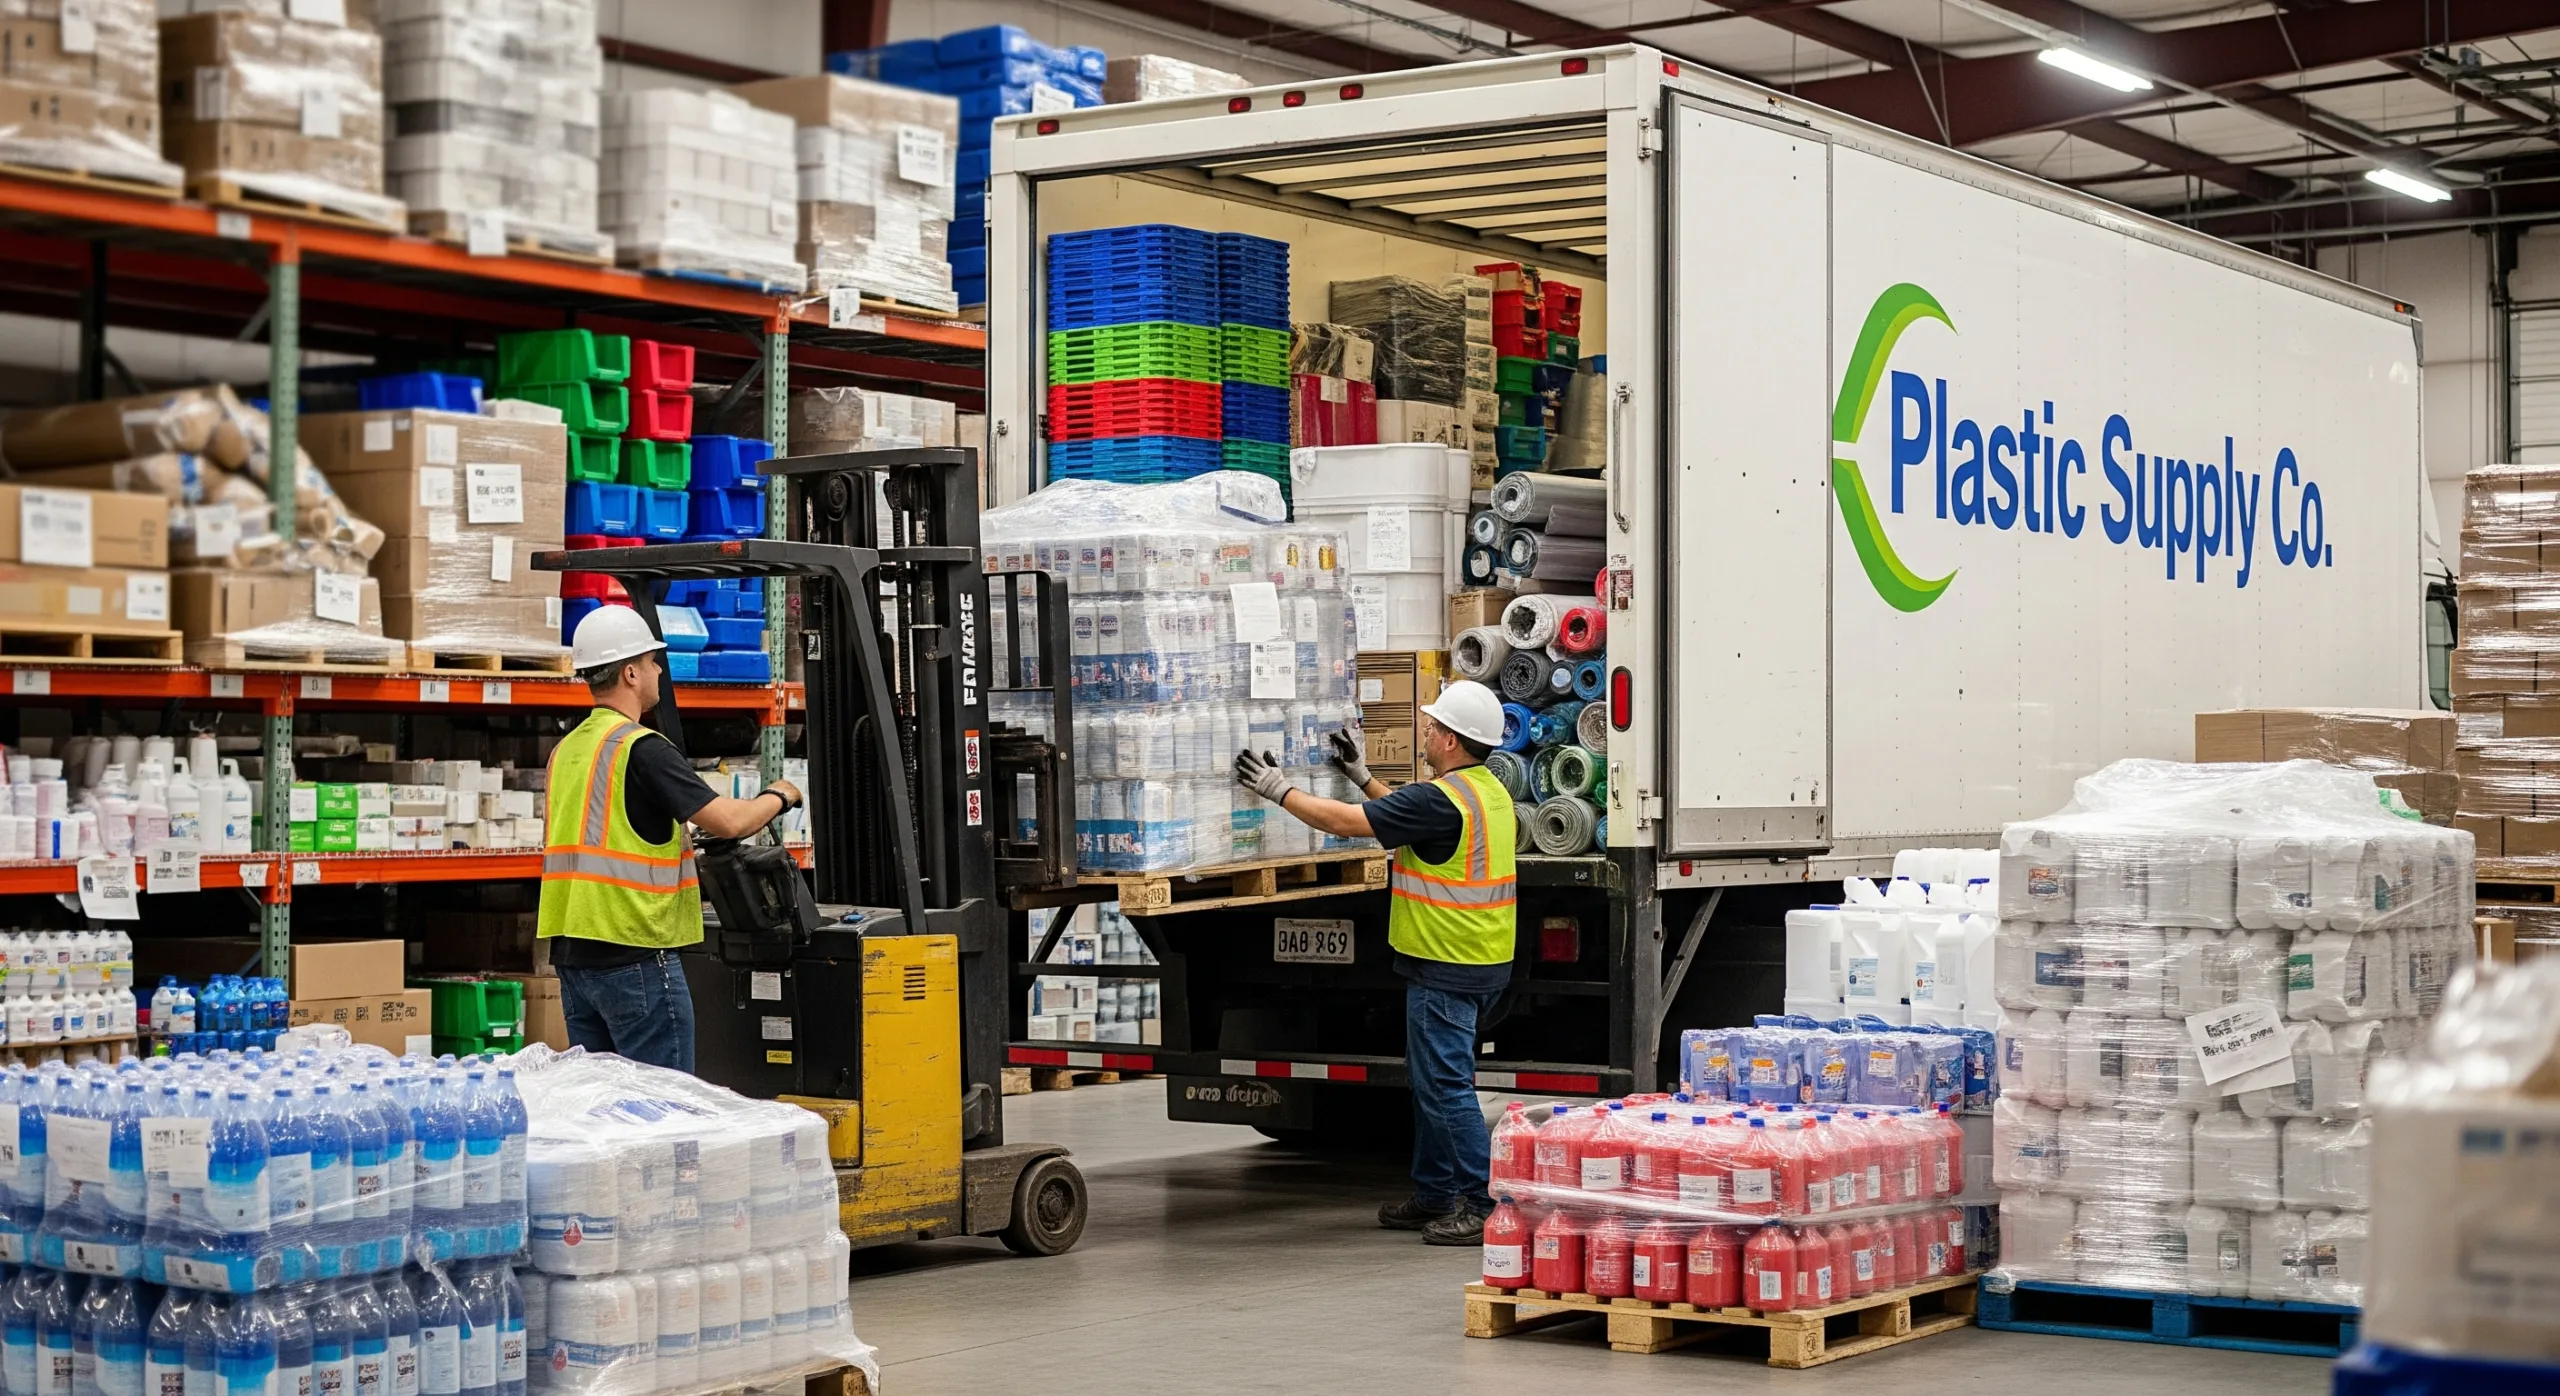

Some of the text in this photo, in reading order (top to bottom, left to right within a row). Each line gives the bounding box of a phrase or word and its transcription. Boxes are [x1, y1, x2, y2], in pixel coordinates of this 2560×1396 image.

[1890, 369, 2333, 589] Plastic Supply Co.
